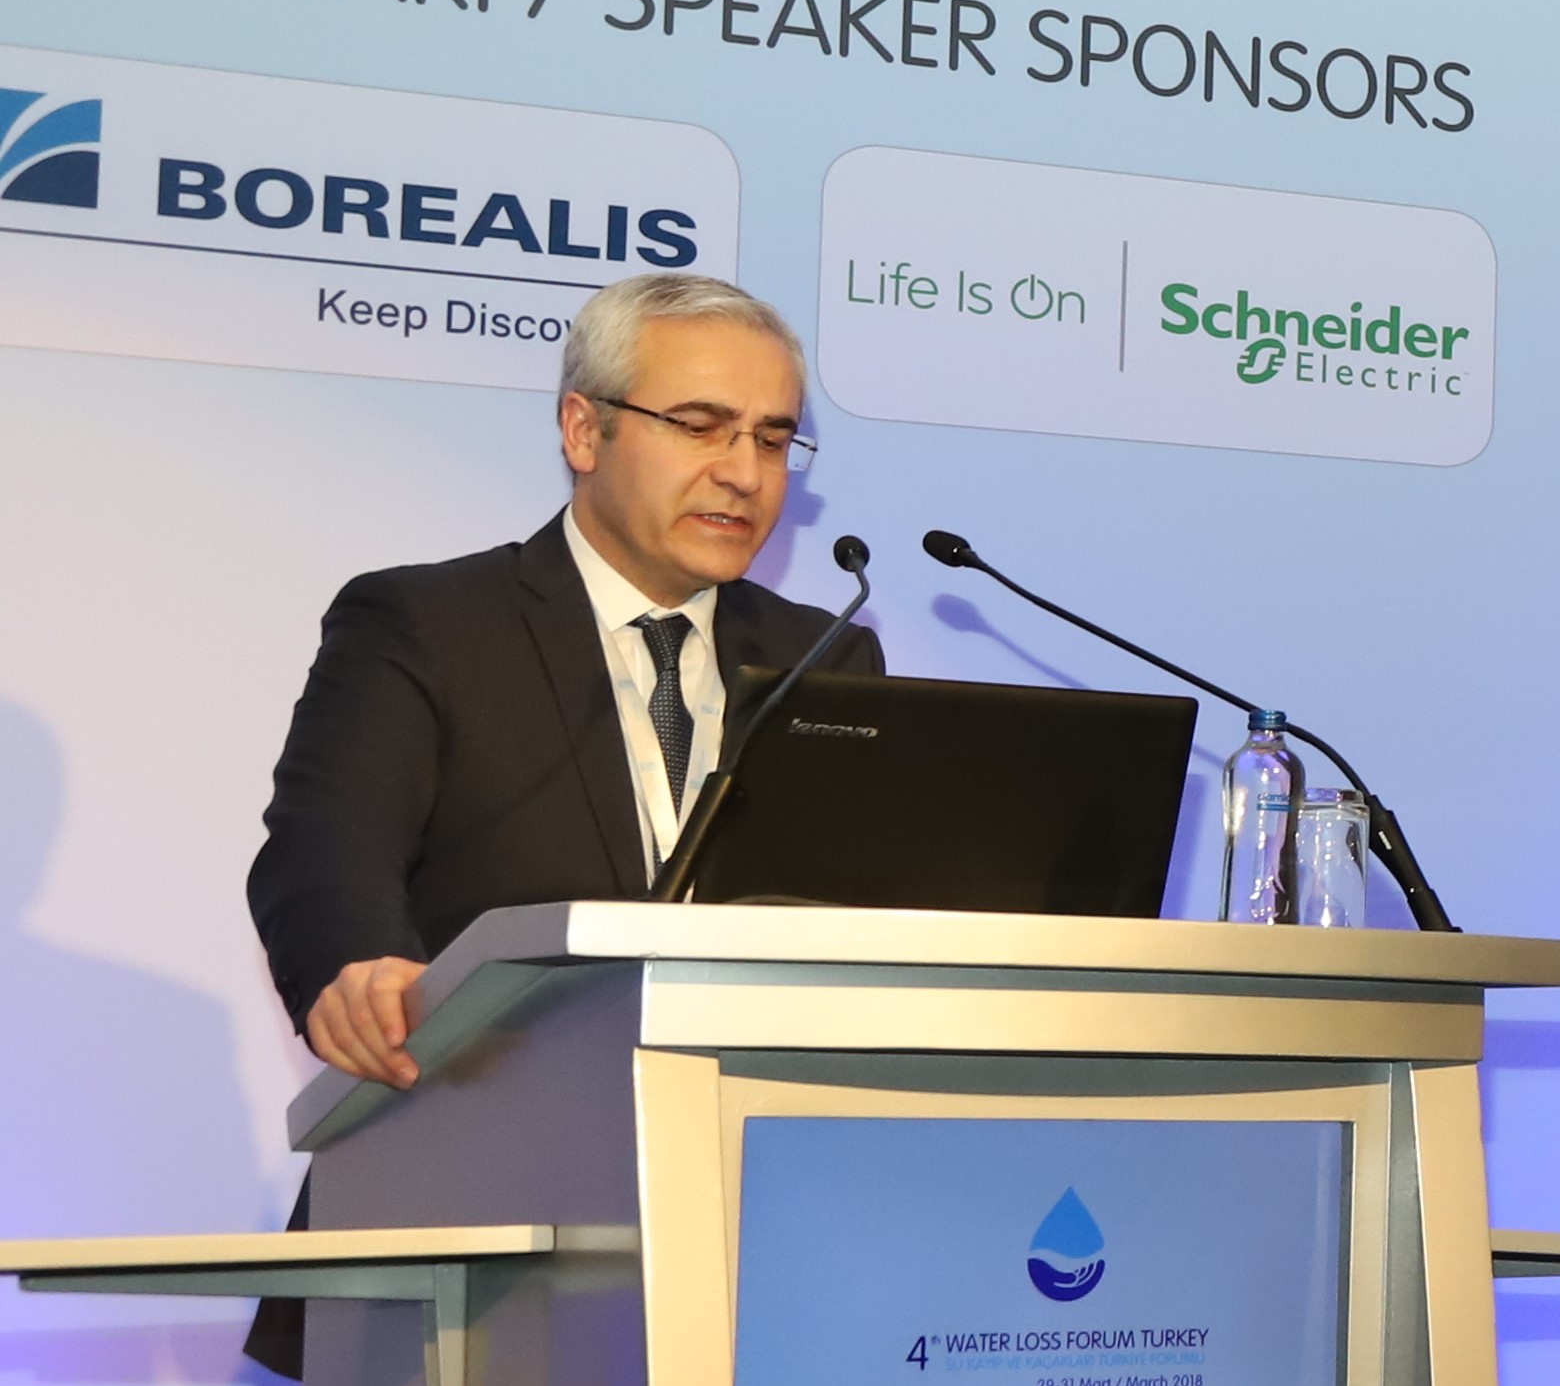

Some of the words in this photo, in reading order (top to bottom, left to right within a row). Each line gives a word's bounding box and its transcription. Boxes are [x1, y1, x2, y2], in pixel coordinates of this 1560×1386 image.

[1025, 9, 1476, 134] SPONSORS
[156, 157, 699, 268] BOREALIS
[317, 288, 428, 337] Keep
[846, 258, 938, 310] Life
[958, 269, 994, 316] Is
[1159, 282, 1470, 360] Schneider
[1295, 351, 1463, 396] Electric
[946, 1333, 1010, 1353] WATER
[1016, 1331, 1061, 1351] LOSS
[1067, 1330, 1134, 1349] FORUM
[1142, 1328, 1209, 1347] TURKEY
